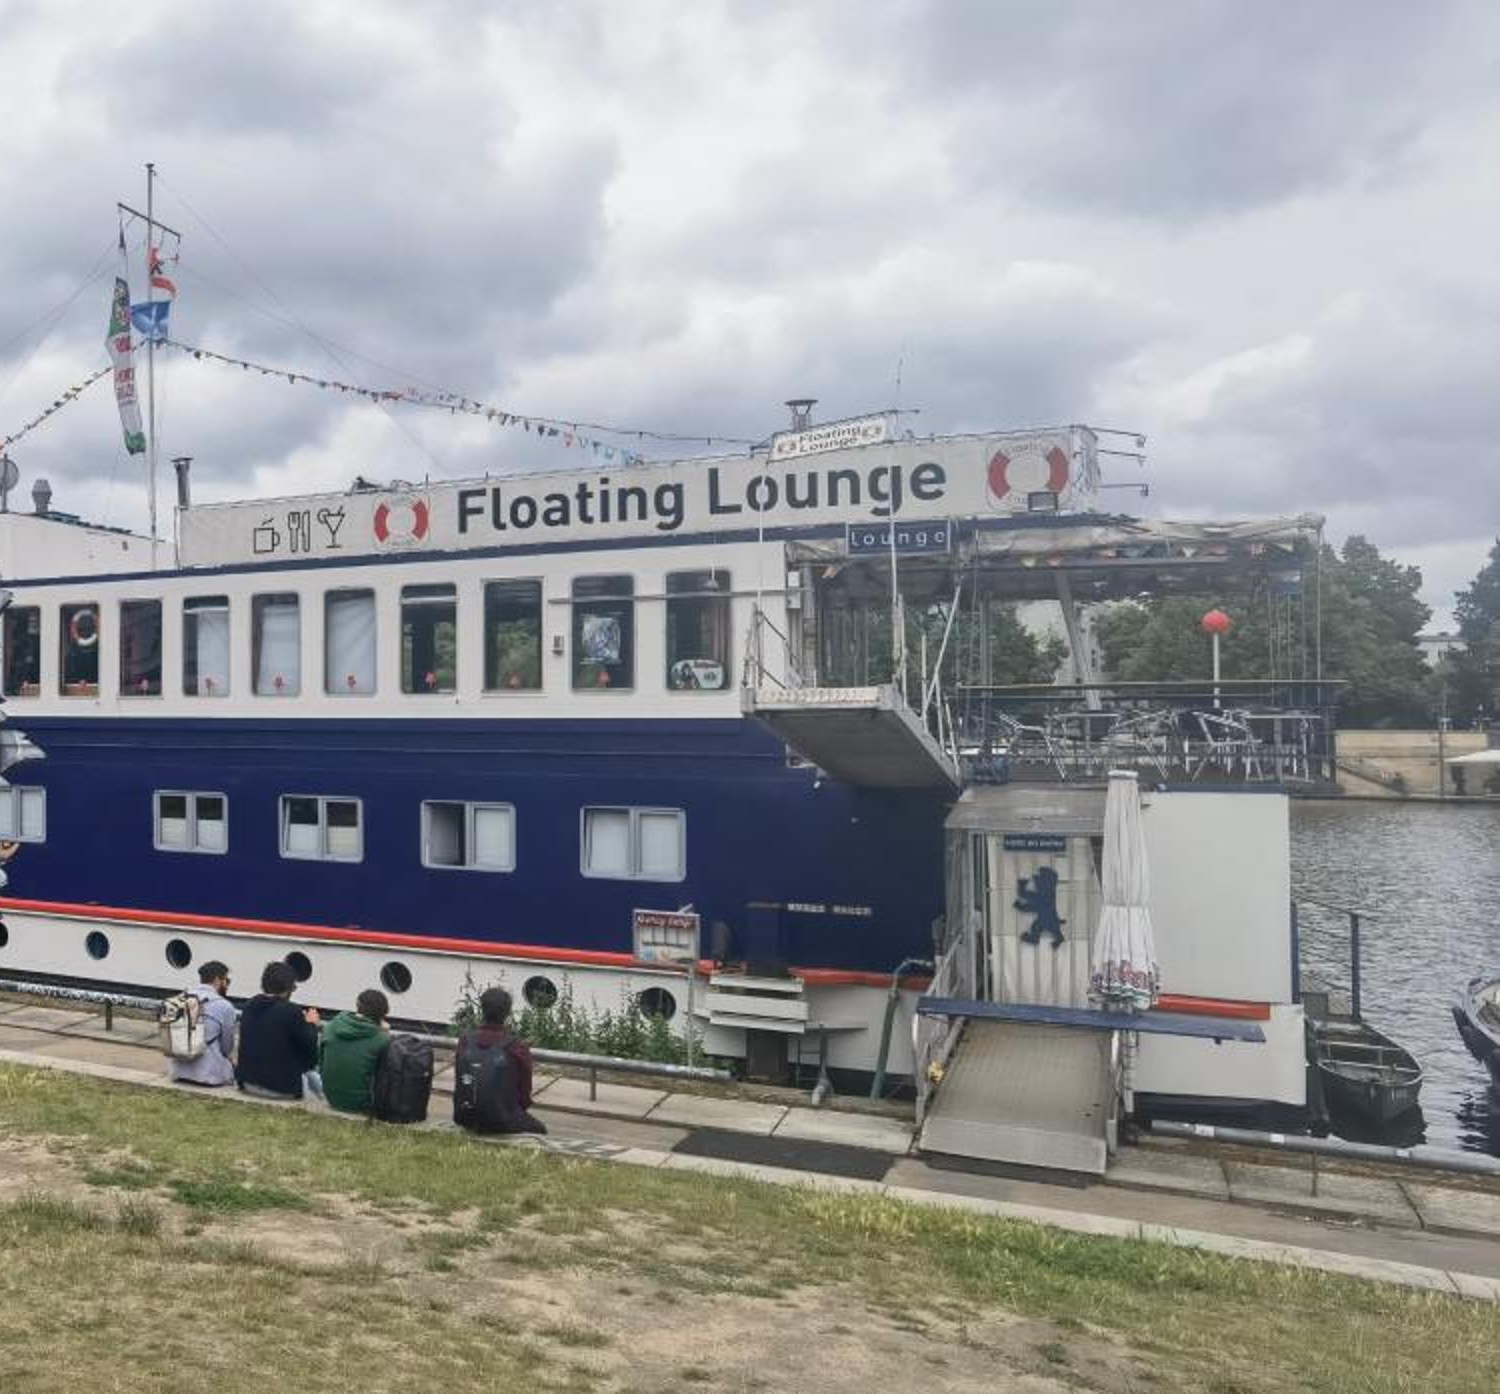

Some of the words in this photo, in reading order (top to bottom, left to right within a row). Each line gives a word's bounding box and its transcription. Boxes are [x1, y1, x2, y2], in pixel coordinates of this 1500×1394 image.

[799, 426, 861, 442] Floating
[799, 437, 858, 453] Lounge
[457, 477, 685, 534] Floating
[708, 462, 947, 516] Lounge
